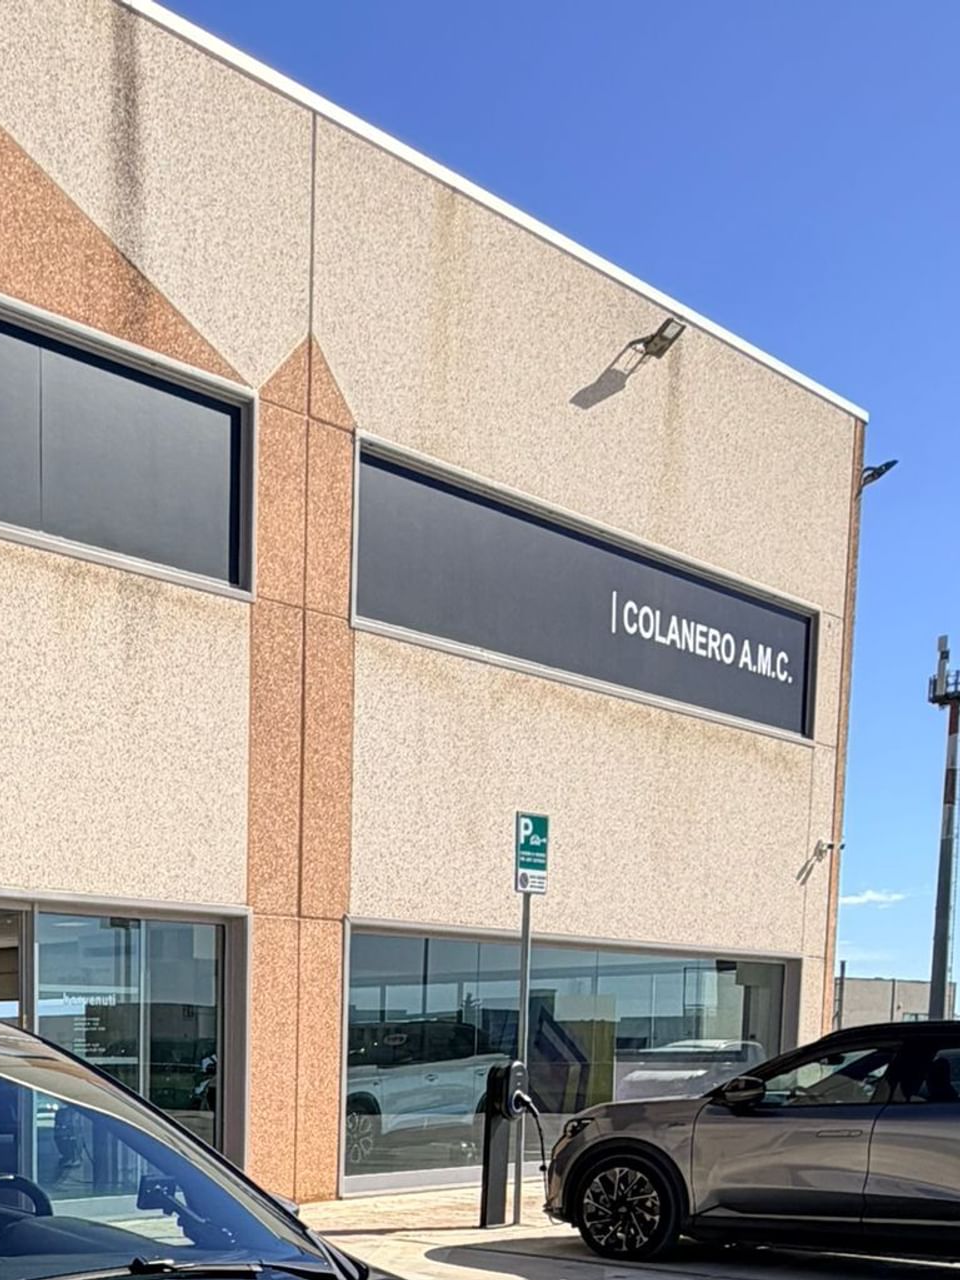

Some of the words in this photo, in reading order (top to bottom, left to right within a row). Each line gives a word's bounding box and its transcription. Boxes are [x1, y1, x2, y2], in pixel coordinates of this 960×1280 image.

[623, 600, 736, 664] COLANERO
[738, 639, 793, 684] A.M.C.
[519, 817, 533, 844] P
